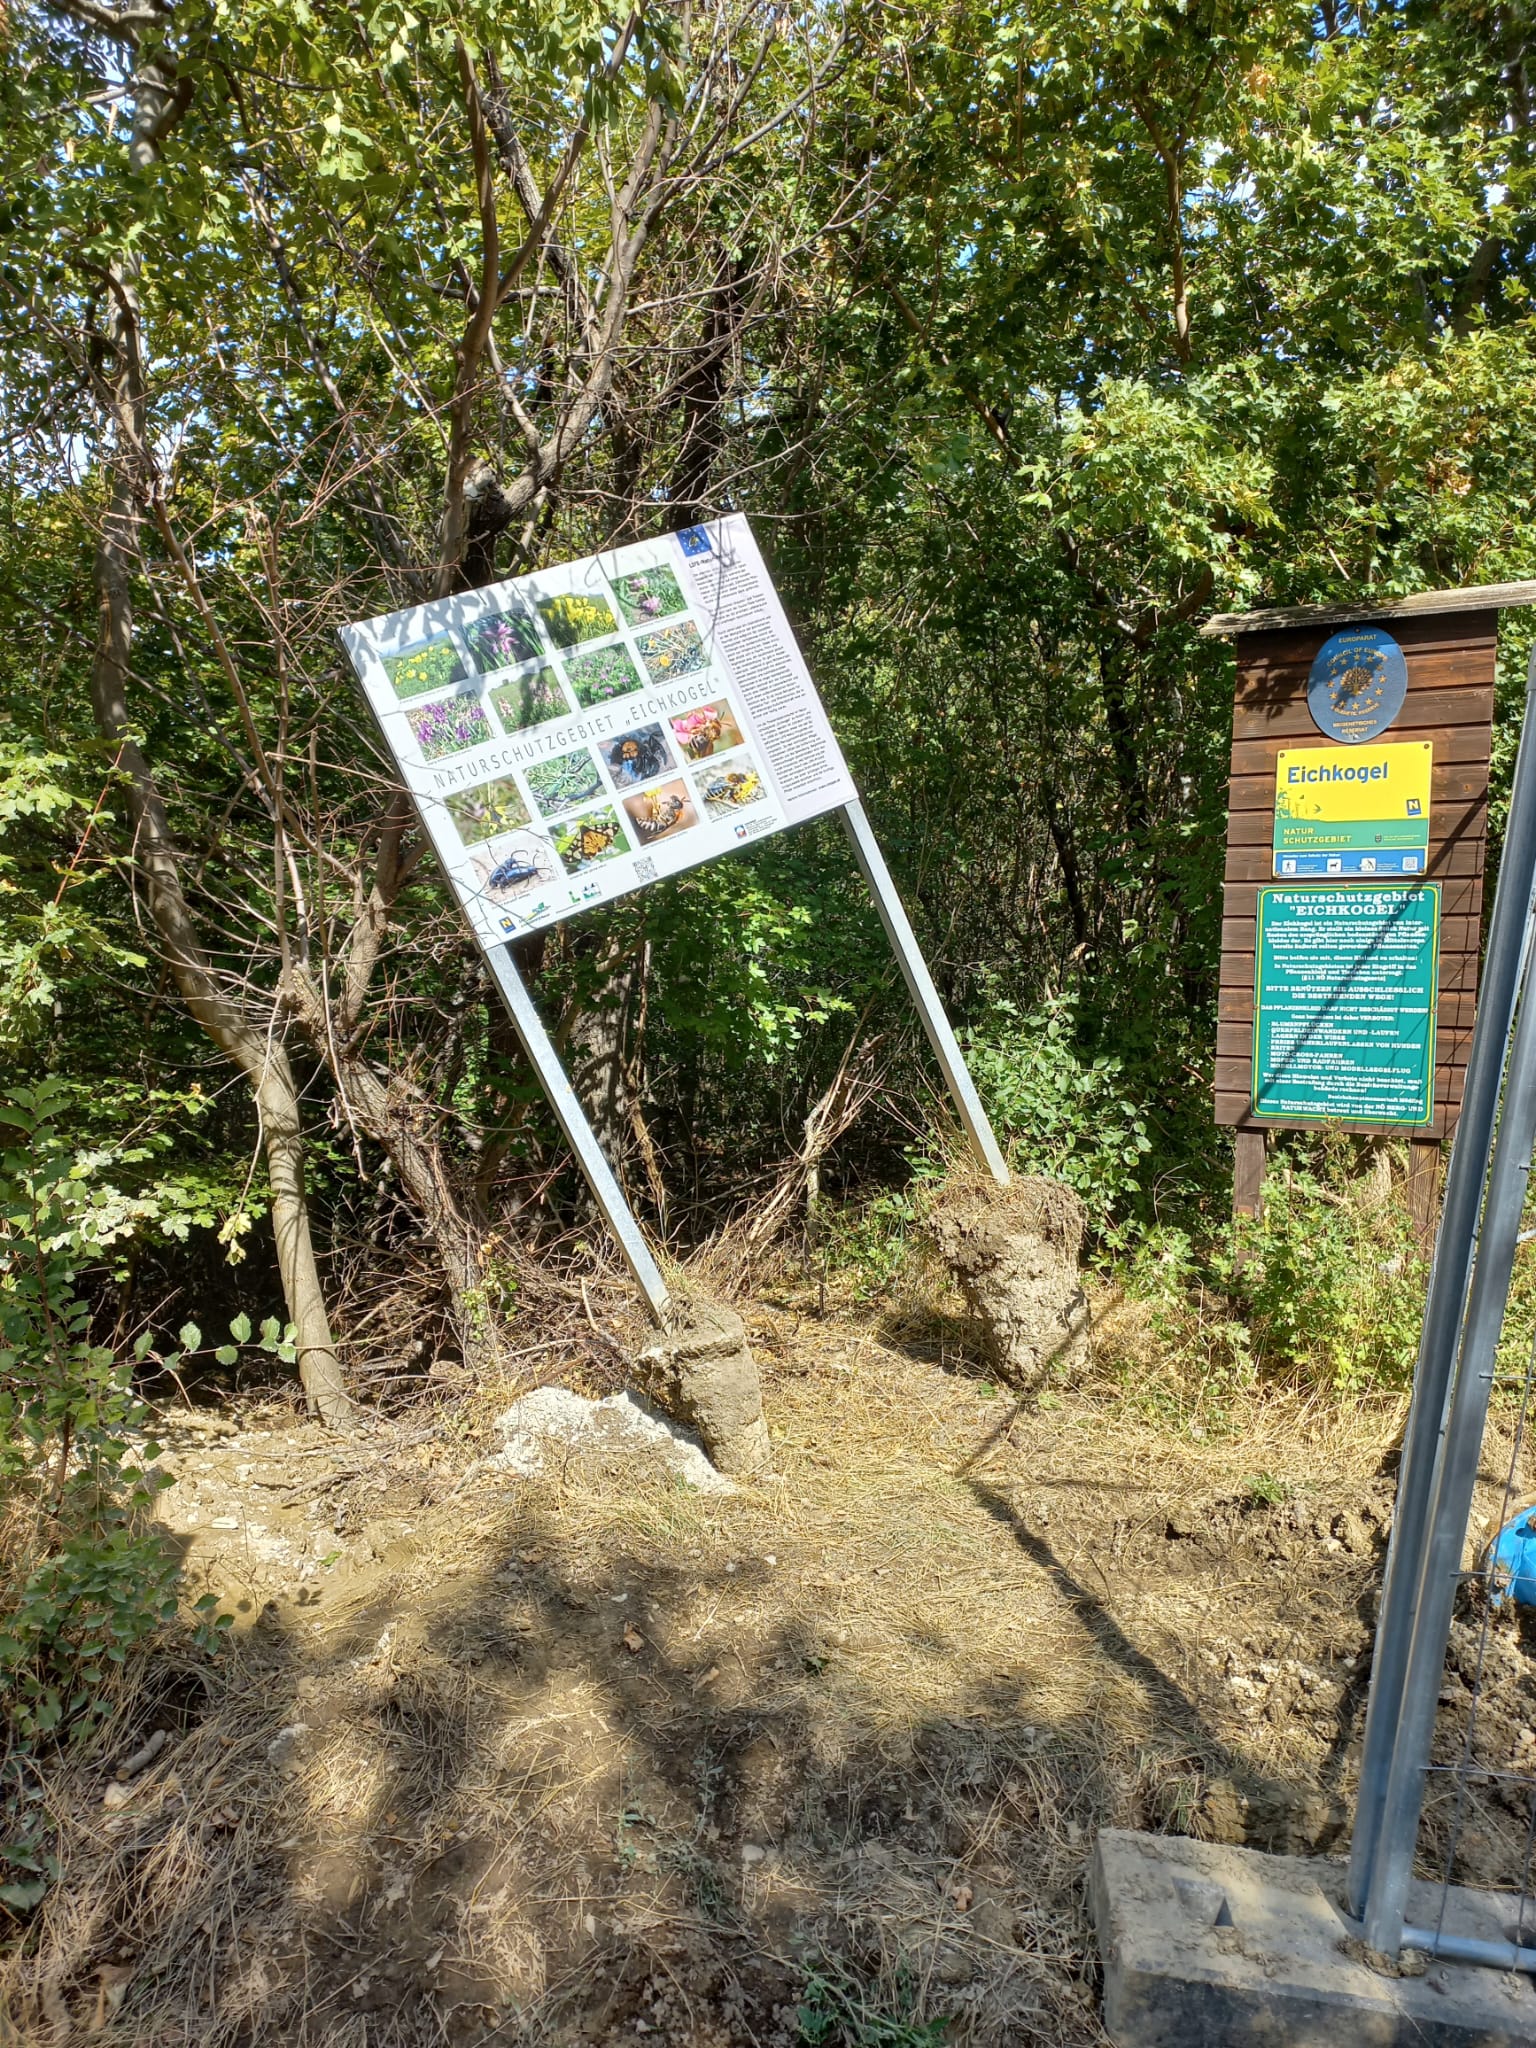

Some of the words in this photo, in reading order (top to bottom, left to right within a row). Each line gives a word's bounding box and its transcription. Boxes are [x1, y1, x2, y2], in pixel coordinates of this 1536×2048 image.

[1327, 649, 1352, 666] COUNCIL
[433, 714, 615, 789] NATURSCHUTZGEBIET
[1287, 761, 1388, 783] Eichkogel
[1283, 827, 1314, 835] NATUR
[1283, 835, 1352, 845] SCHUTZGEBIET
[1272, 891, 1425, 905] Naturschutzgebiet
[1289, 904, 1405, 916] "EICHKOGEL"
